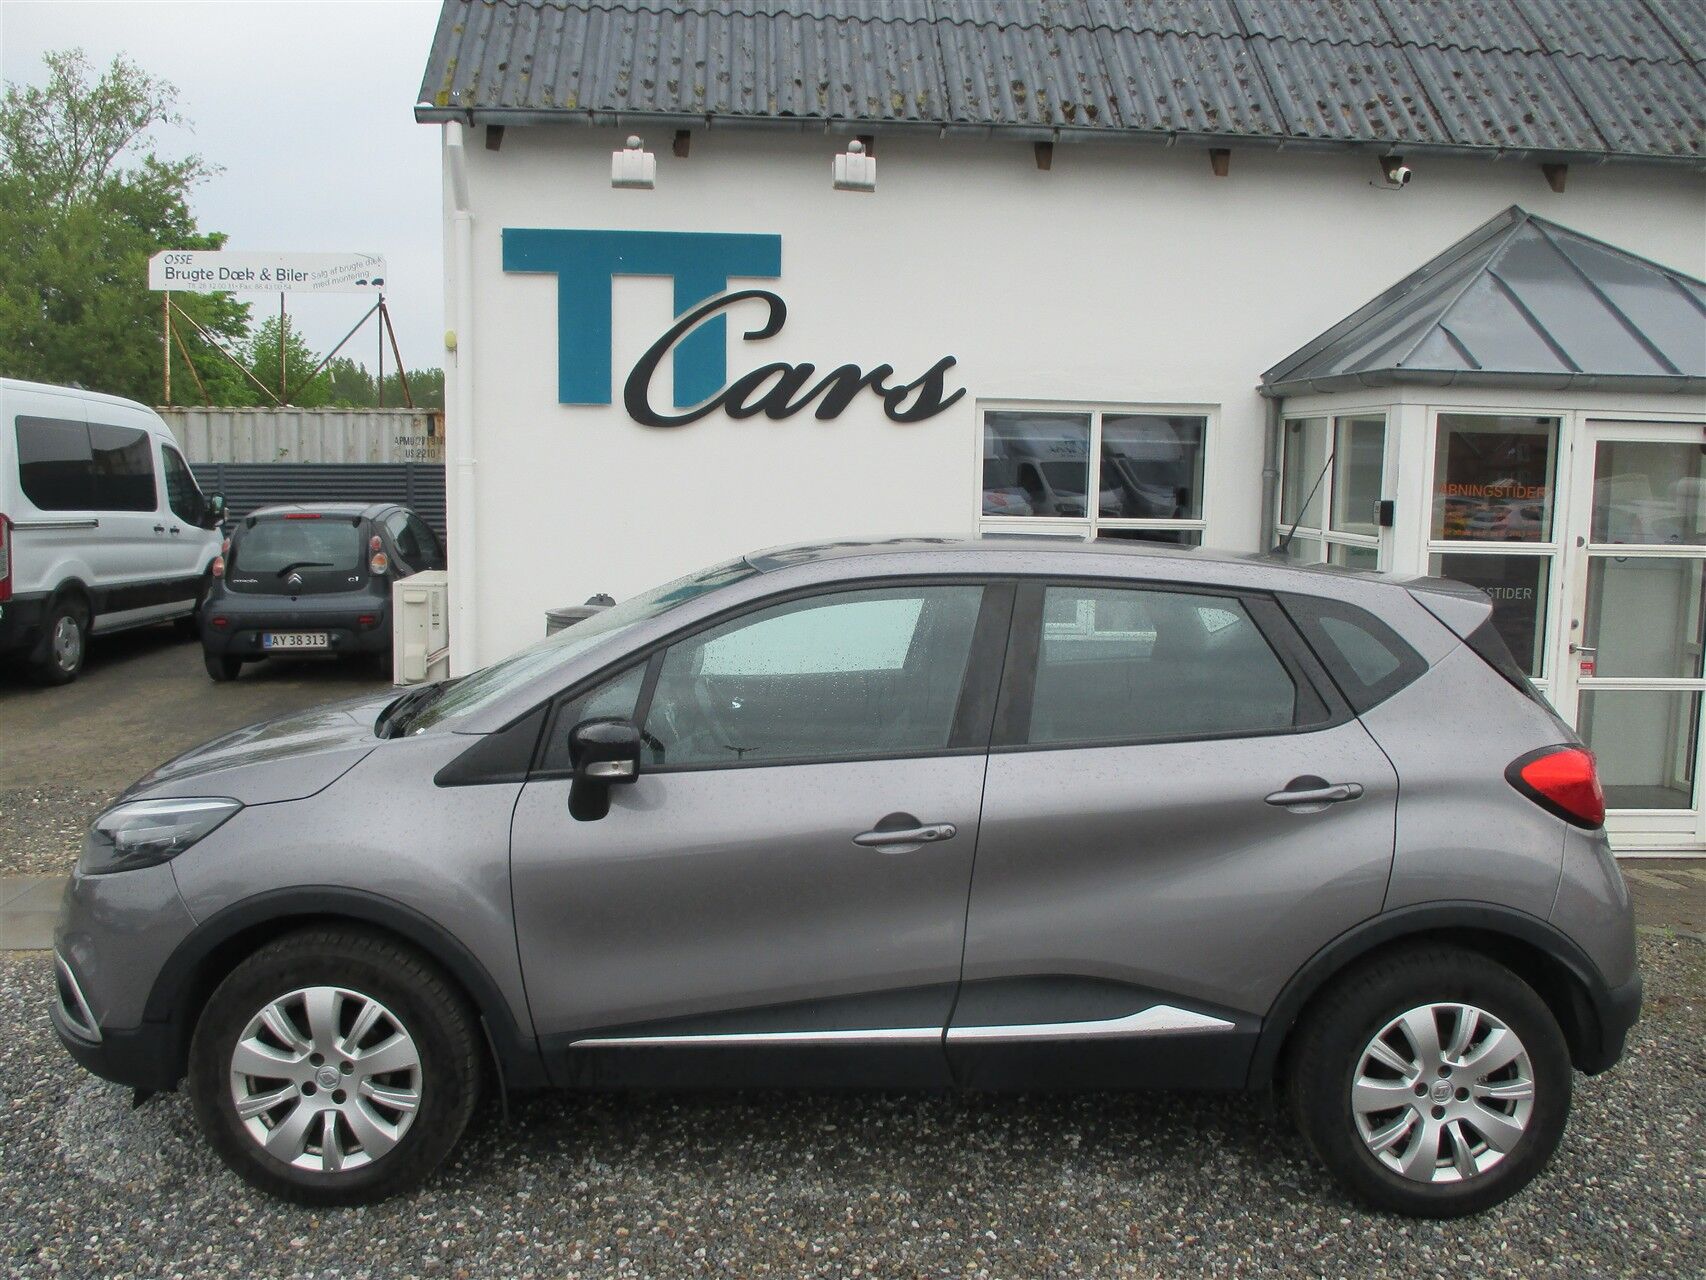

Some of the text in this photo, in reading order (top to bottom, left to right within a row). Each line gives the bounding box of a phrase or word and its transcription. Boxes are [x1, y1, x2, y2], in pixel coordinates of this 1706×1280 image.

[164, 254, 193, 265] OSSE
[165, 267, 309, 283] Brugte Dæk & Biler
[313, 279, 330, 289] med
[502, 227, 966, 428] TT Cars
[272, 634, 326, 646] AY 38 313
